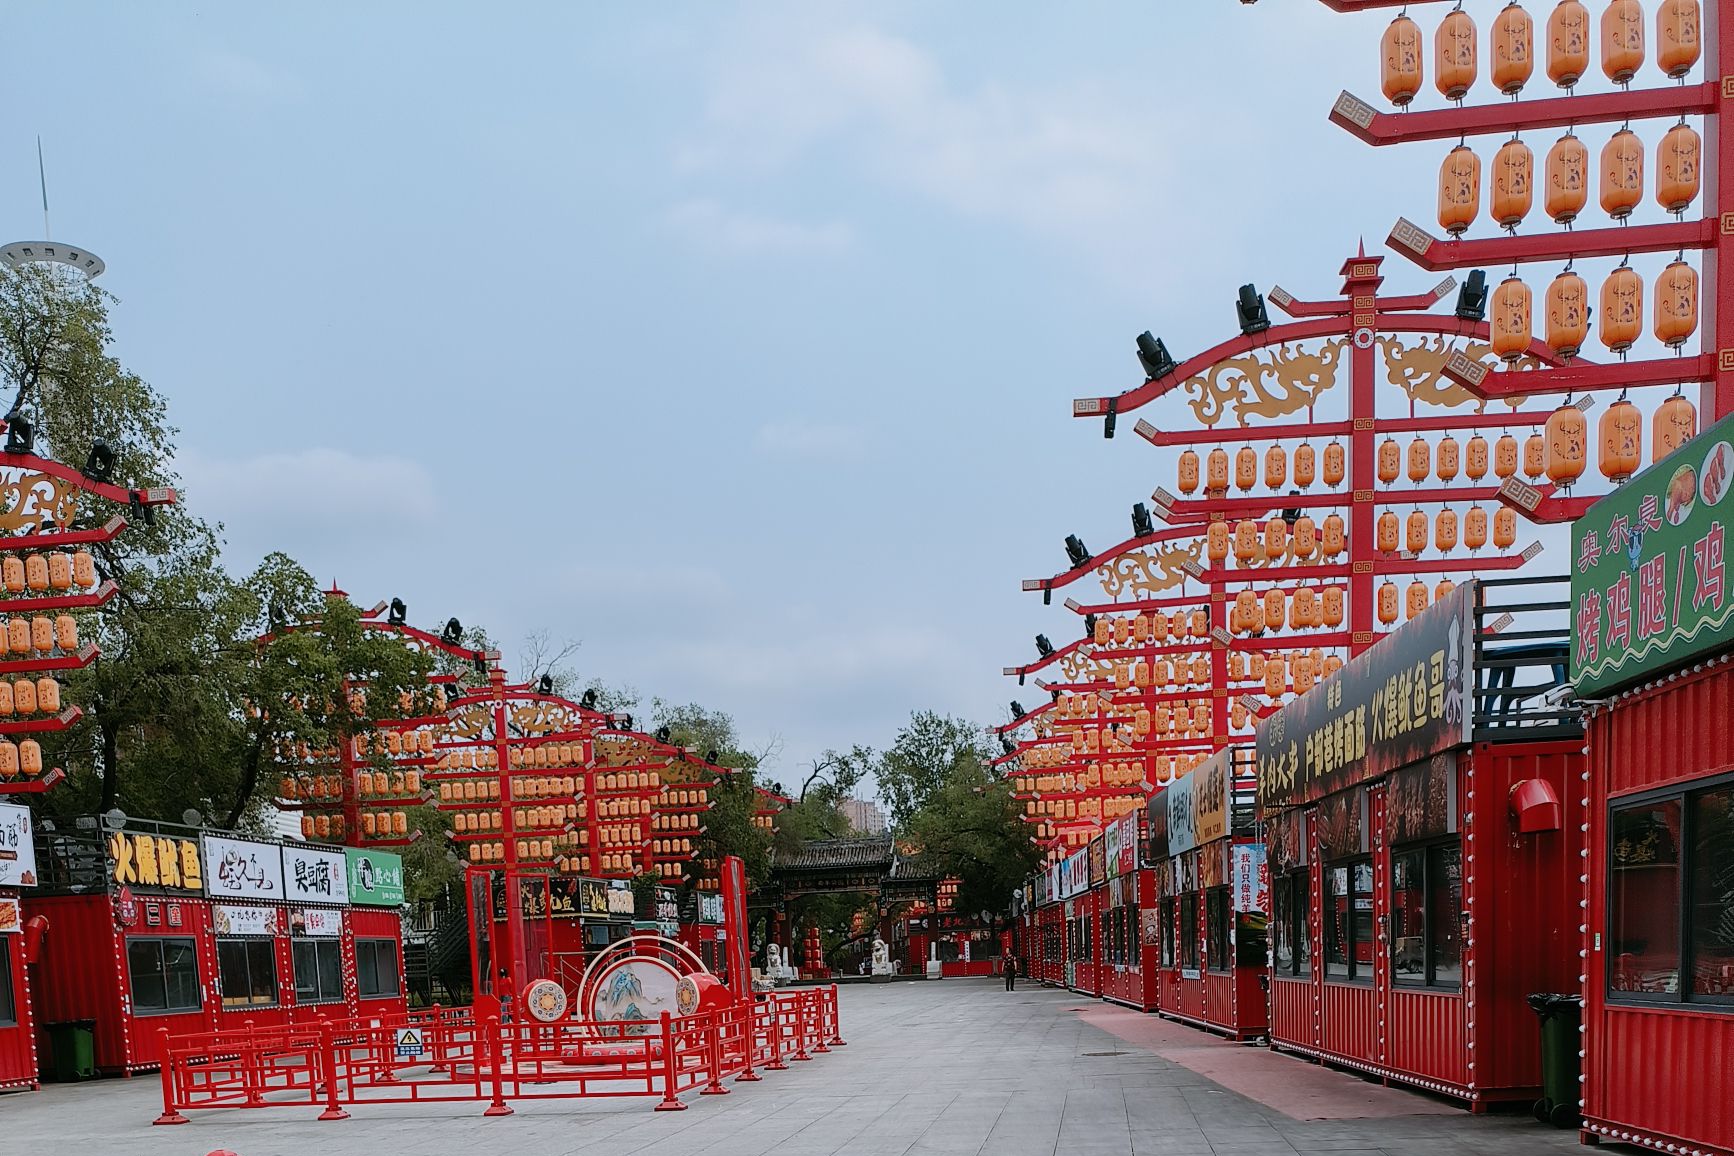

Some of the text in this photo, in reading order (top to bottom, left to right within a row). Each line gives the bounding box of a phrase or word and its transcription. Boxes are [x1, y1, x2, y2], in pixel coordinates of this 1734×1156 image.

[1577, 494, 1663, 574] 奥尔良
[1576, 520, 1734, 669] 烤鸡腿/鸡
[1371, 649, 1445, 745] 火爆鱿鱼哥
[1258, 739, 1299, 805] 羊肉大串
[1305, 703, 1366, 783] 户部巷烤面筋
[0, 823, 18, 848] 筋
[109, 831, 203, 889] 火爆鱿鱼
[294, 857, 331, 896] 臭豆腐
